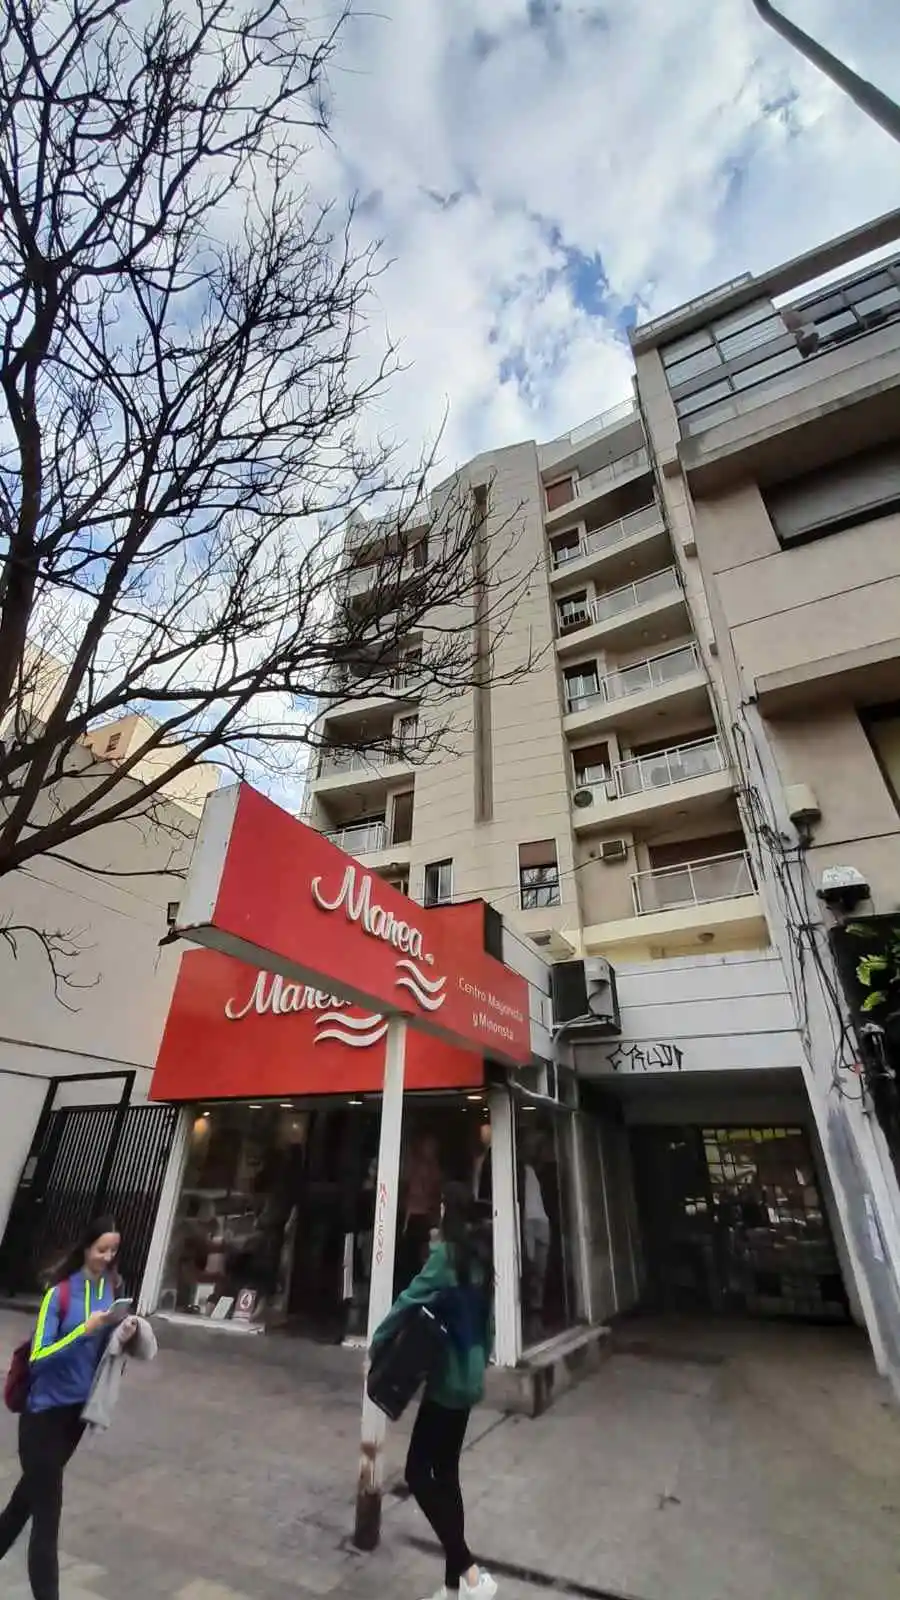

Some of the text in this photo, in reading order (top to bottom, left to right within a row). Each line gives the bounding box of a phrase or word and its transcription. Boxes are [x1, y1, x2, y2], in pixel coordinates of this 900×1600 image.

[458, 977, 524, 1022] Centro Mayorista
[479, 1012, 514, 1041] Minorista
